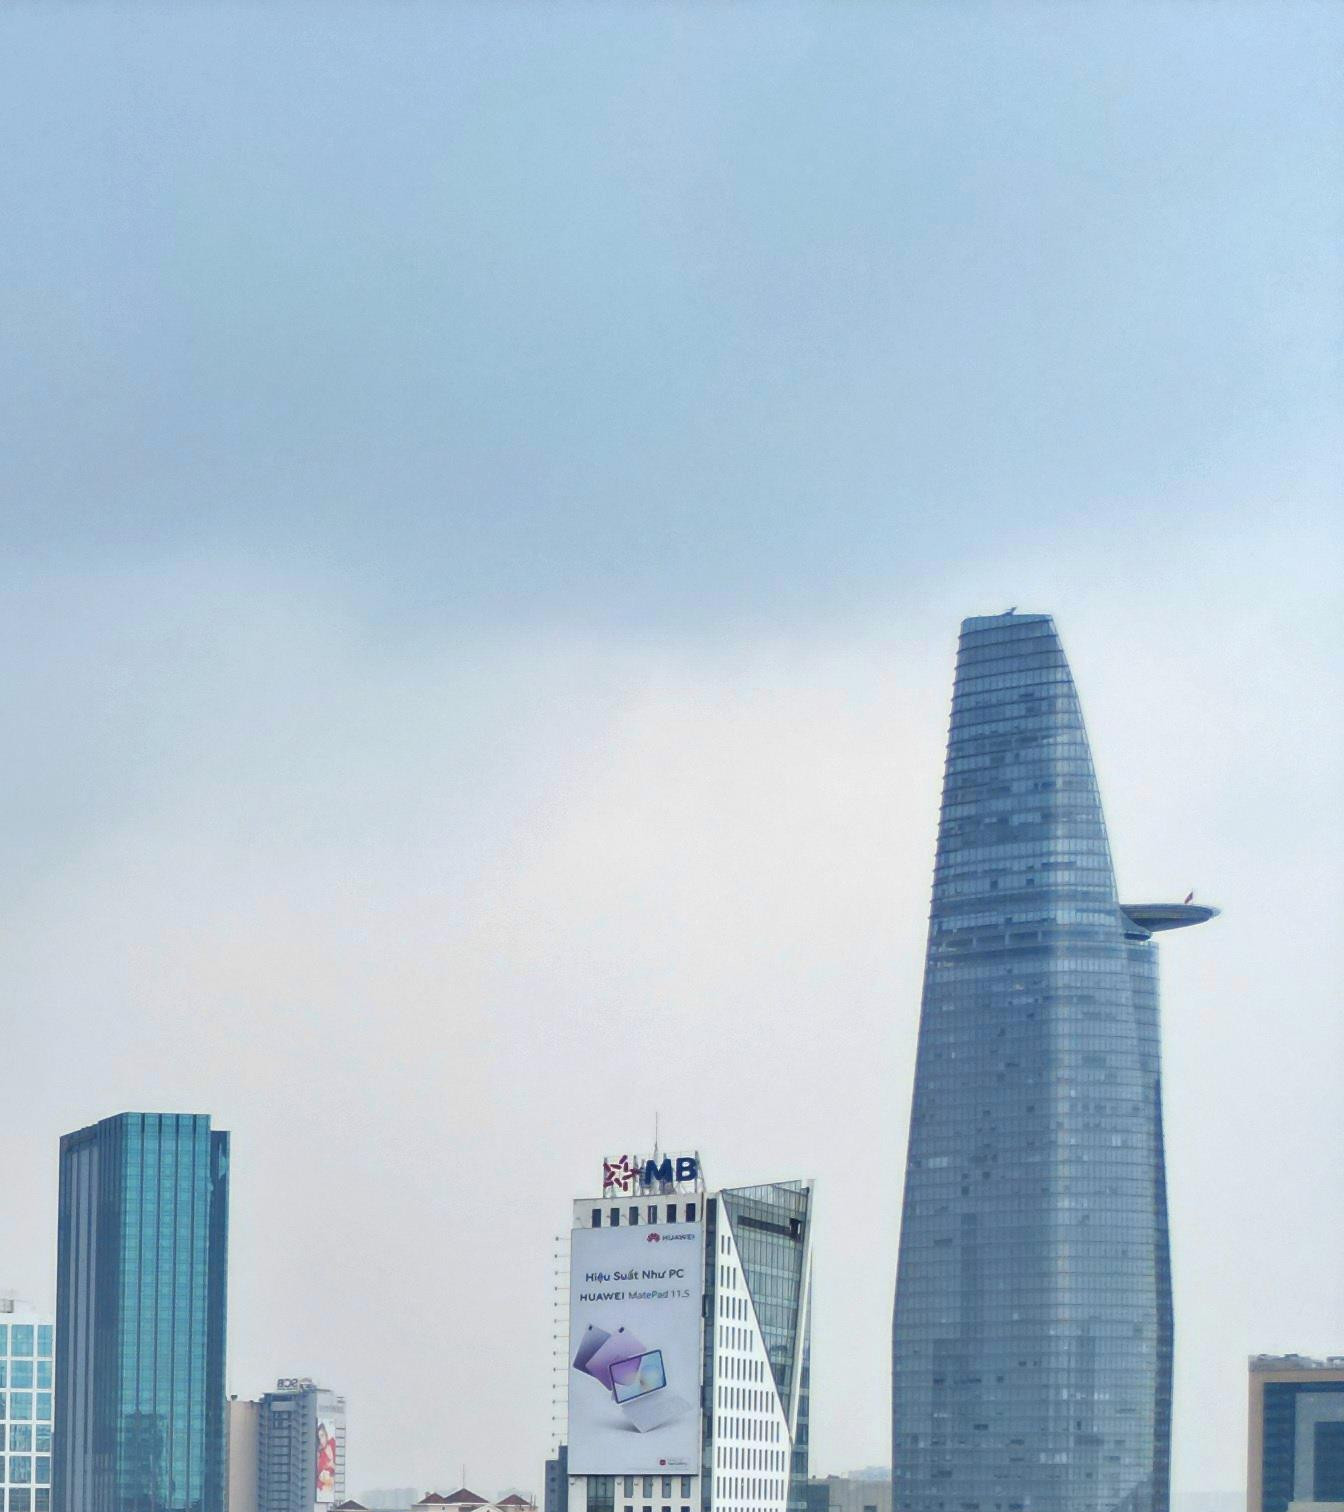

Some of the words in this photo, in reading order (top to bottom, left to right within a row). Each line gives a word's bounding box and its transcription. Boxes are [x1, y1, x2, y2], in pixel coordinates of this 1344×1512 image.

[644, 1157, 699, 1186] MB
[585, 1272, 611, 1284] Hiệu
[613, 1268, 639, 1281] Suất
[642, 1269, 666, 1280] Như
[668, 1268, 685, 1279] PC
[579, 1291, 625, 1302] HUAWEI
[628, 1289, 669, 1300] MatePad
